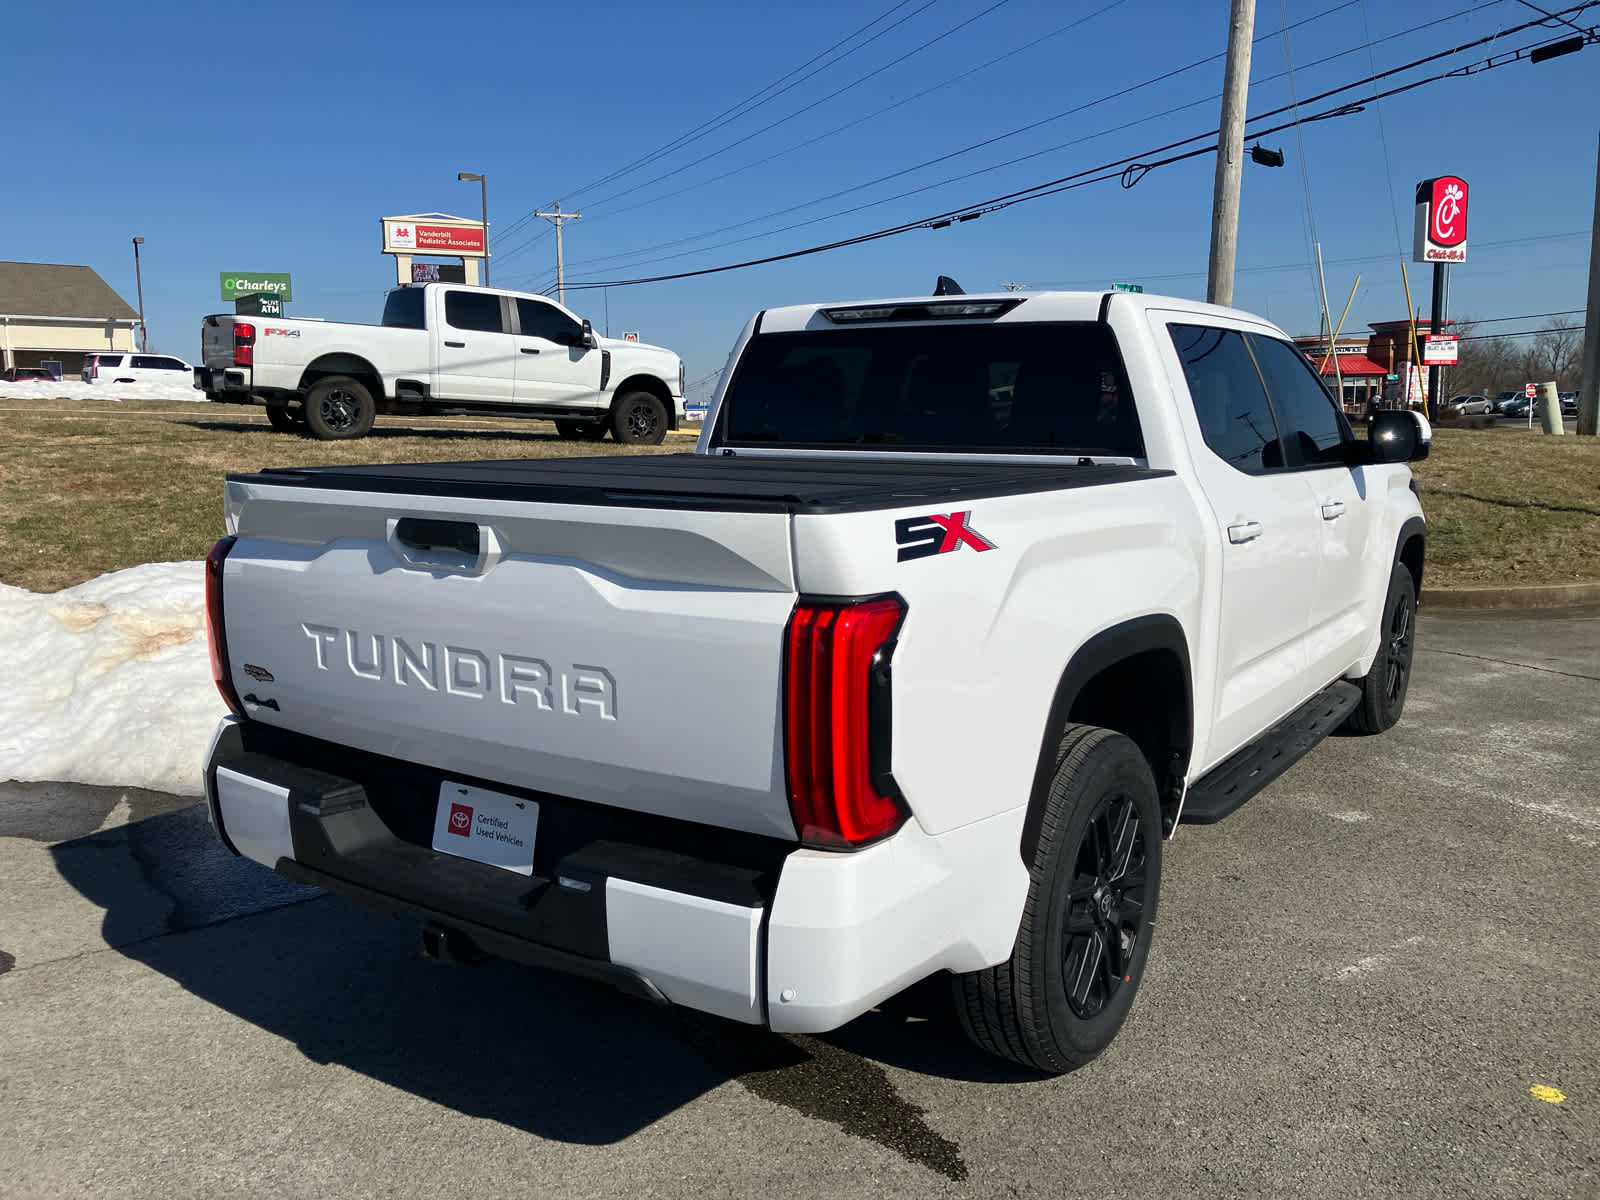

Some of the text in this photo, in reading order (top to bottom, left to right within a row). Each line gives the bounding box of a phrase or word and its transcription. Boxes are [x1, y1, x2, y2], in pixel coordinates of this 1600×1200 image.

[419, 237, 446, 245] Pediatric
[448, 238, 480, 247] Associates
[261, 305, 279, 314] ATM
[264, 327, 301, 337] FX4
[301, 622, 617, 720] TUNDRA
[477, 814, 508, 830] Certified
[476, 826, 523, 847] Used Vehicles
